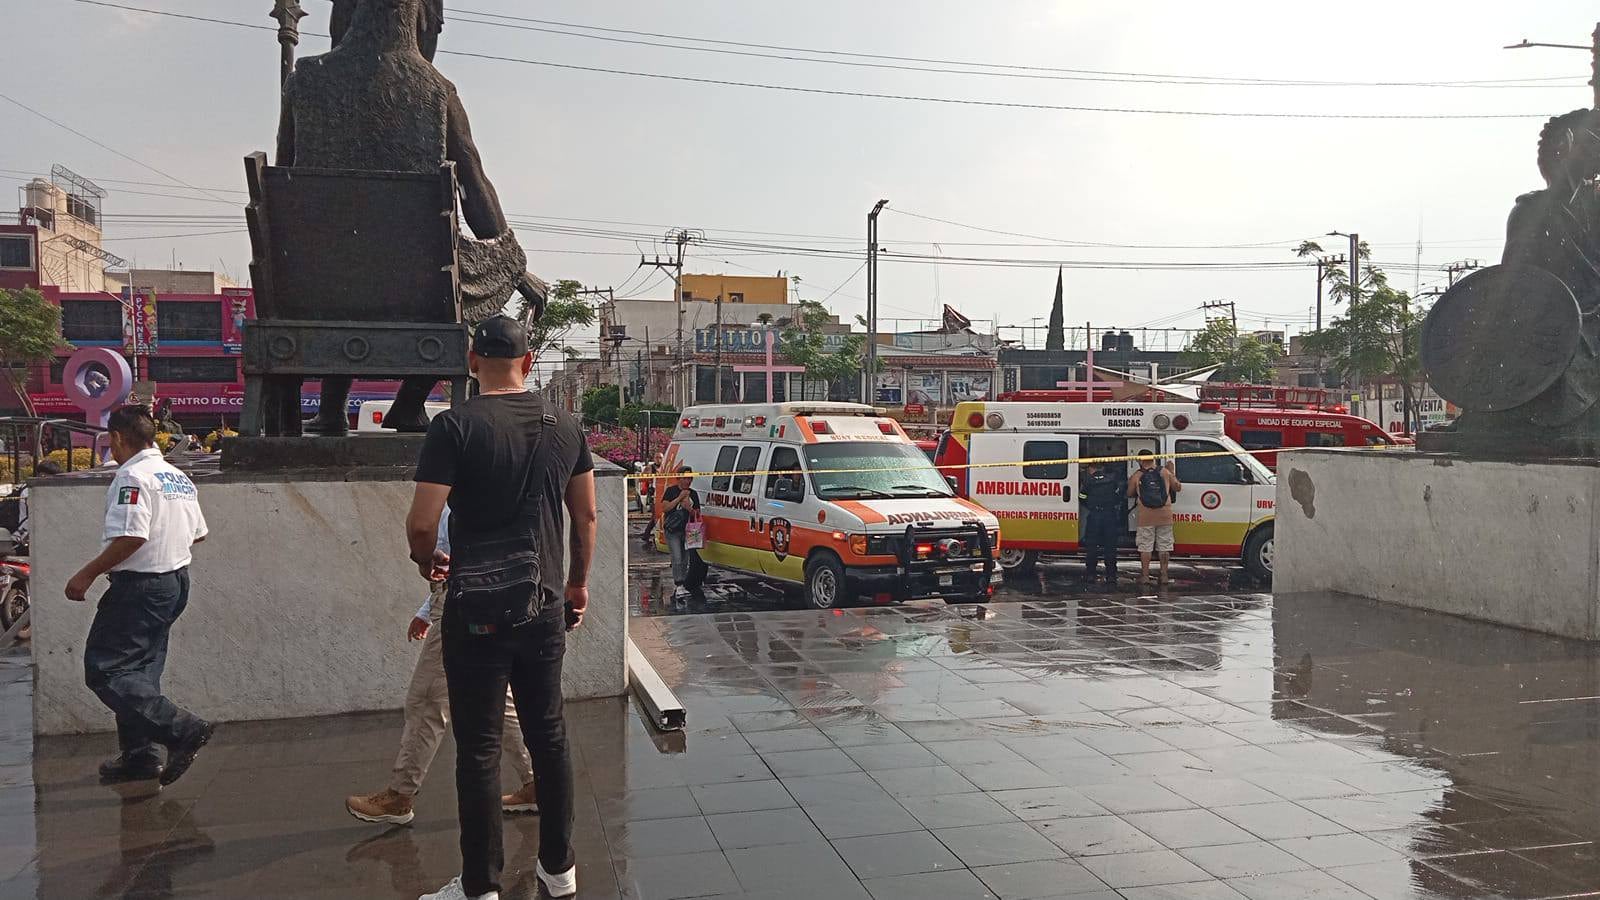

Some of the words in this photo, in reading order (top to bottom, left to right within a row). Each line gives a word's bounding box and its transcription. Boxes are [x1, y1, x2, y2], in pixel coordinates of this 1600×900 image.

[169, 397, 209, 405] ENTRO
[1101, 408, 1144, 416] URGENCIAS
[1107, 419, 1141, 427] BASICAS
[1257, 418, 1281, 426] UNIDAD
[1291, 419, 1314, 427] EQUIPO
[1315, 420, 1344, 429] ESPECIAL
[976, 481, 1062, 496] AMBULANCIA
[706, 493, 757, 511] AMBULANCIA
[989, 511, 1028, 520] RGENCIAS
[1029, 512, 1078, 521] PREHOSPITAL
